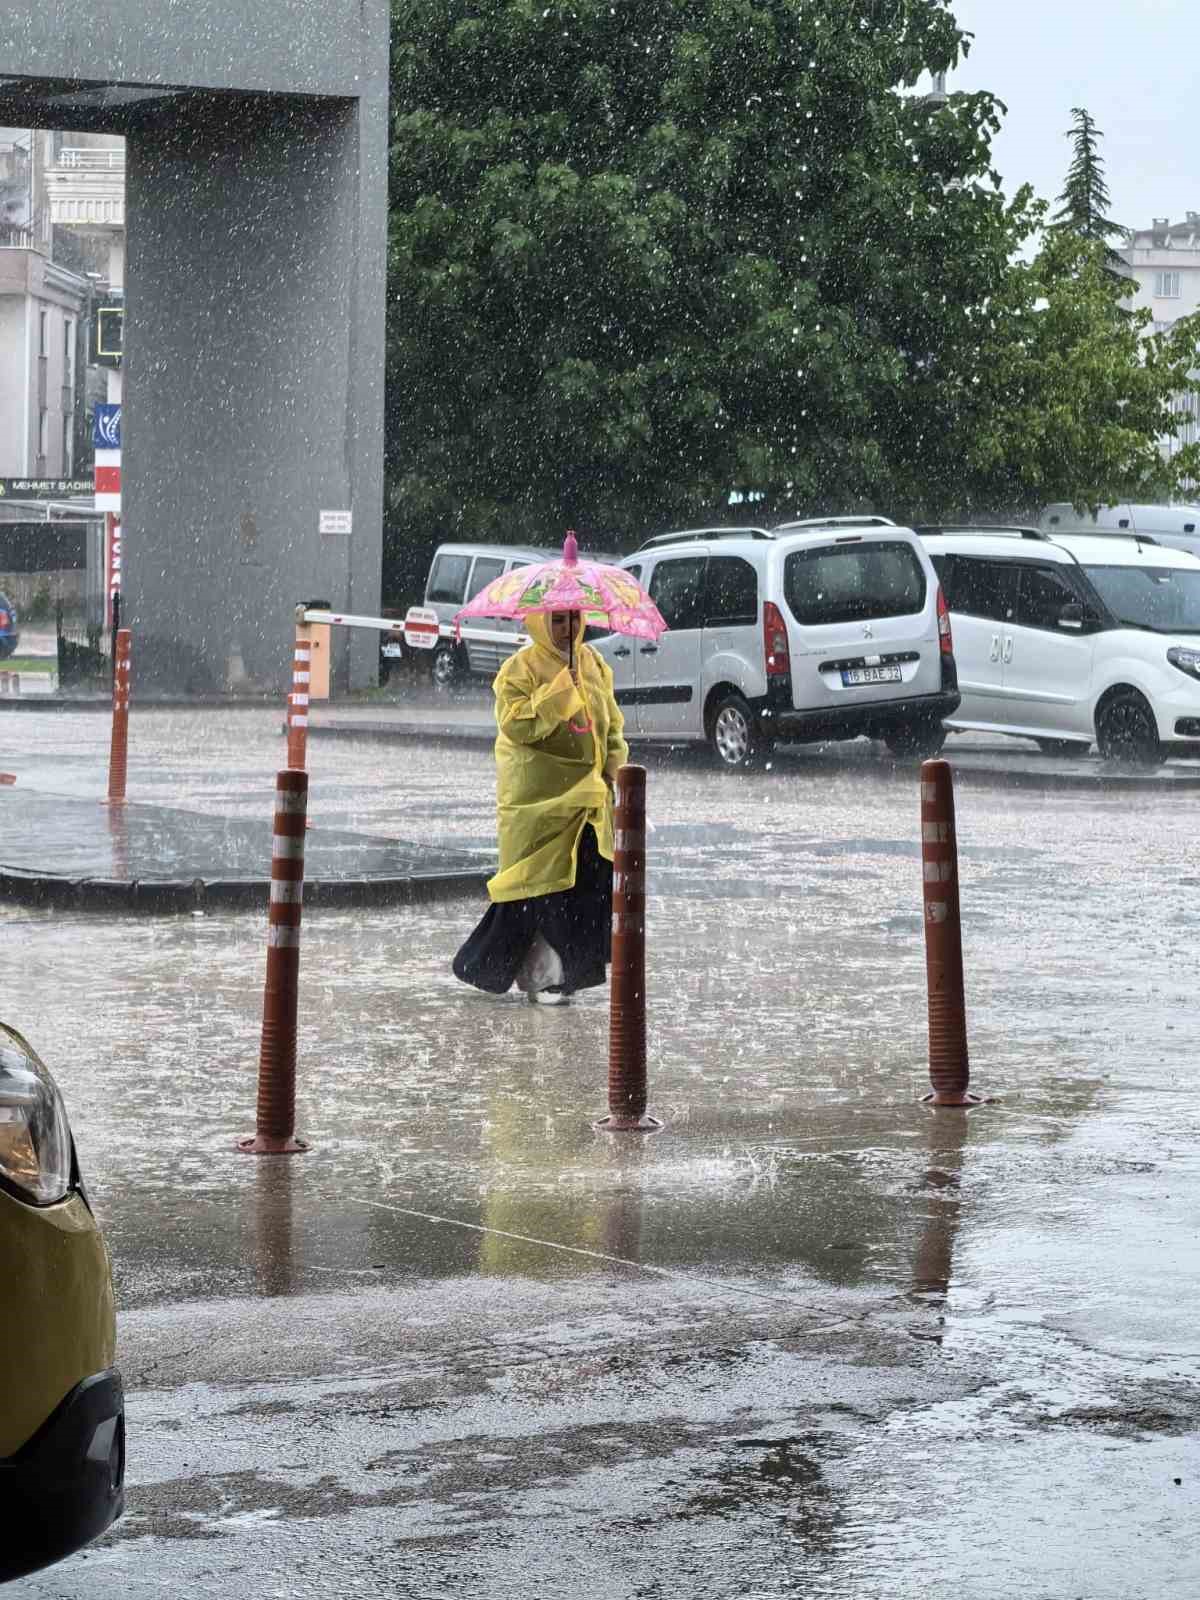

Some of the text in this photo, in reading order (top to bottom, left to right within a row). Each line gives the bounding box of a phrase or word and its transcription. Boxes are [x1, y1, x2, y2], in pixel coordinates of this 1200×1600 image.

[12, 481, 55, 490] MEHMET
[849, 670, 860, 681] 16
[864, 668, 886, 681] BAE
